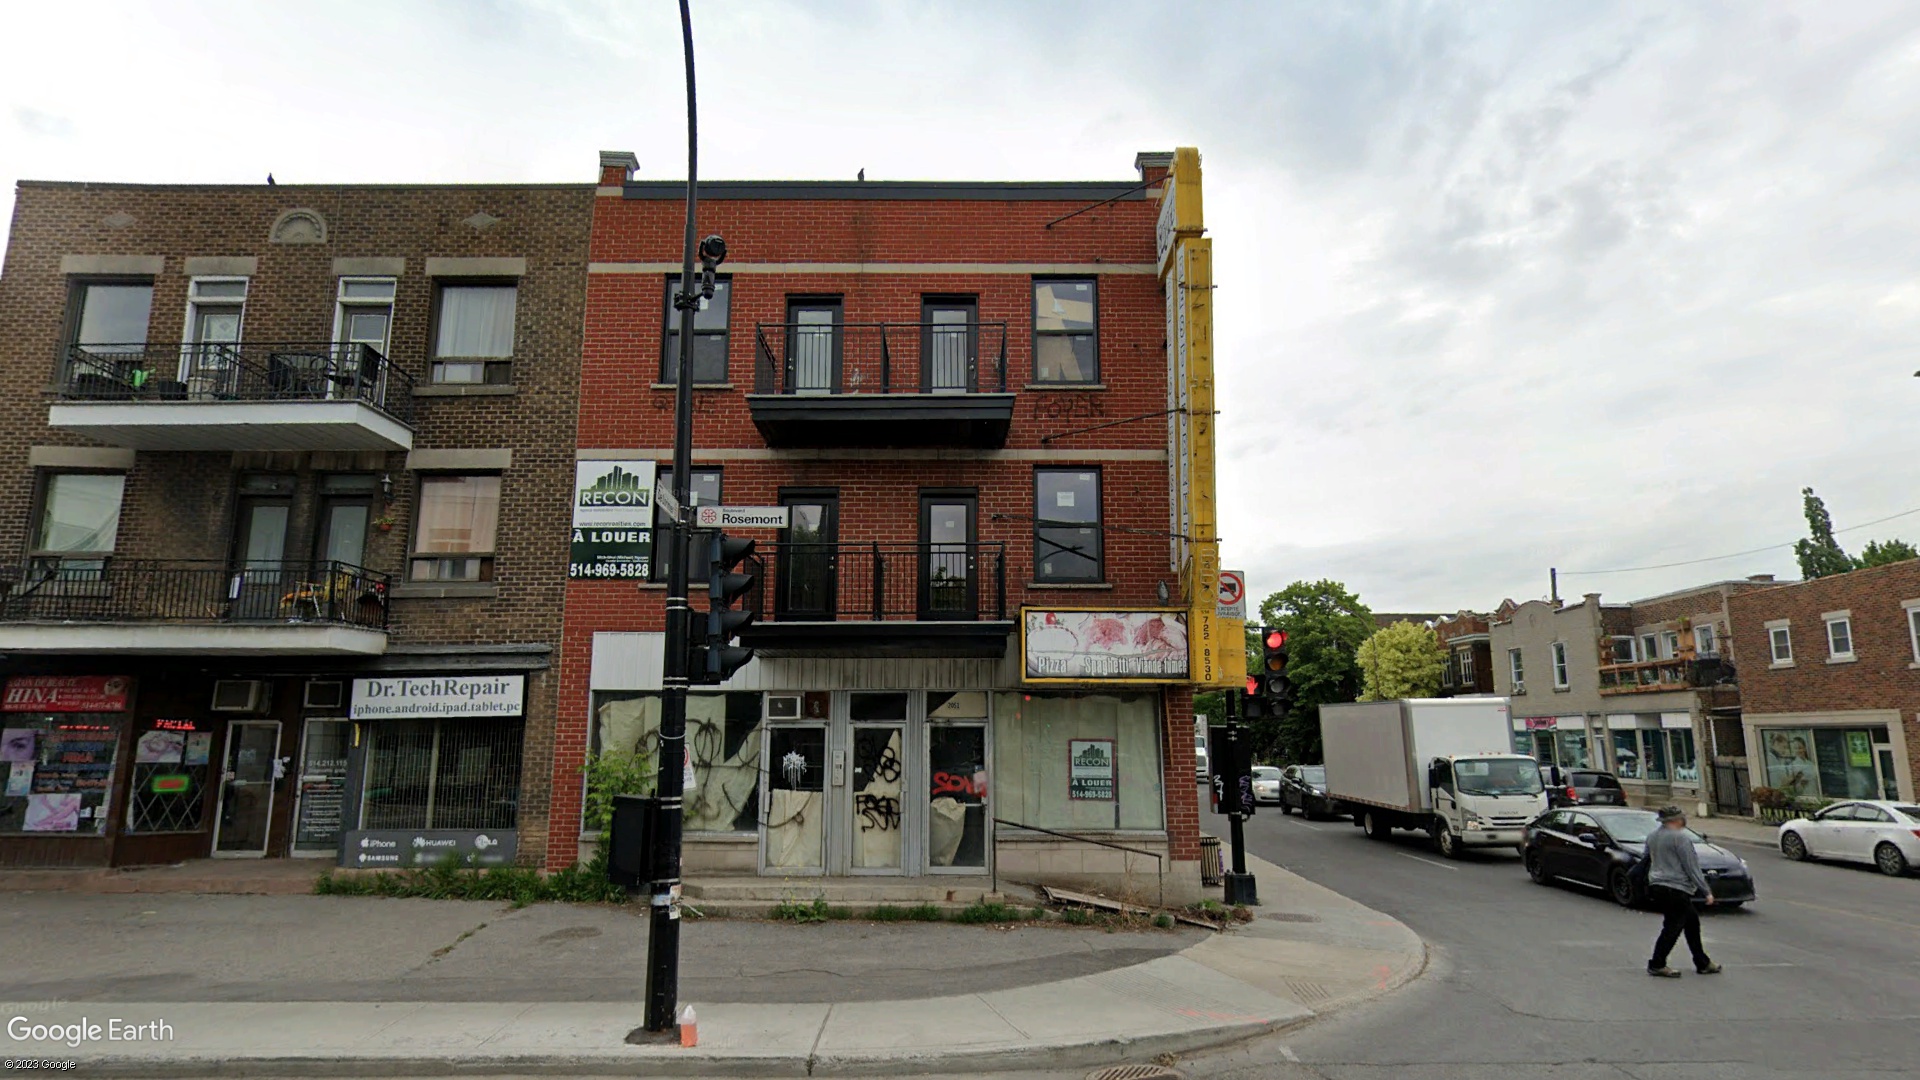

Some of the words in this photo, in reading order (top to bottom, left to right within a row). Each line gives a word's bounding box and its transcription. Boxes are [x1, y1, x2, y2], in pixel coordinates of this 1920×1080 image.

[582, 491, 647, 505] RECON
[722, 513, 783, 525] Rosemont
[572, 529, 585, 543] À
[591, 531, 651, 543] LOUER
[1038, 656, 1068, 674] Pizza
[1084, 656, 1130, 676] Spaghetti
[1136, 656, 1162, 674] Viande
[7, 688, 58, 703] HINA
[366, 678, 511, 700] Dr.TechRepair
[353, 701, 521, 717] iphone.android.ipad.tablet.pc
[1075, 757, 1109, 766] RECON
[369, 839, 397, 848] iPhone
[425, 839, 457, 847] HUAWEI
